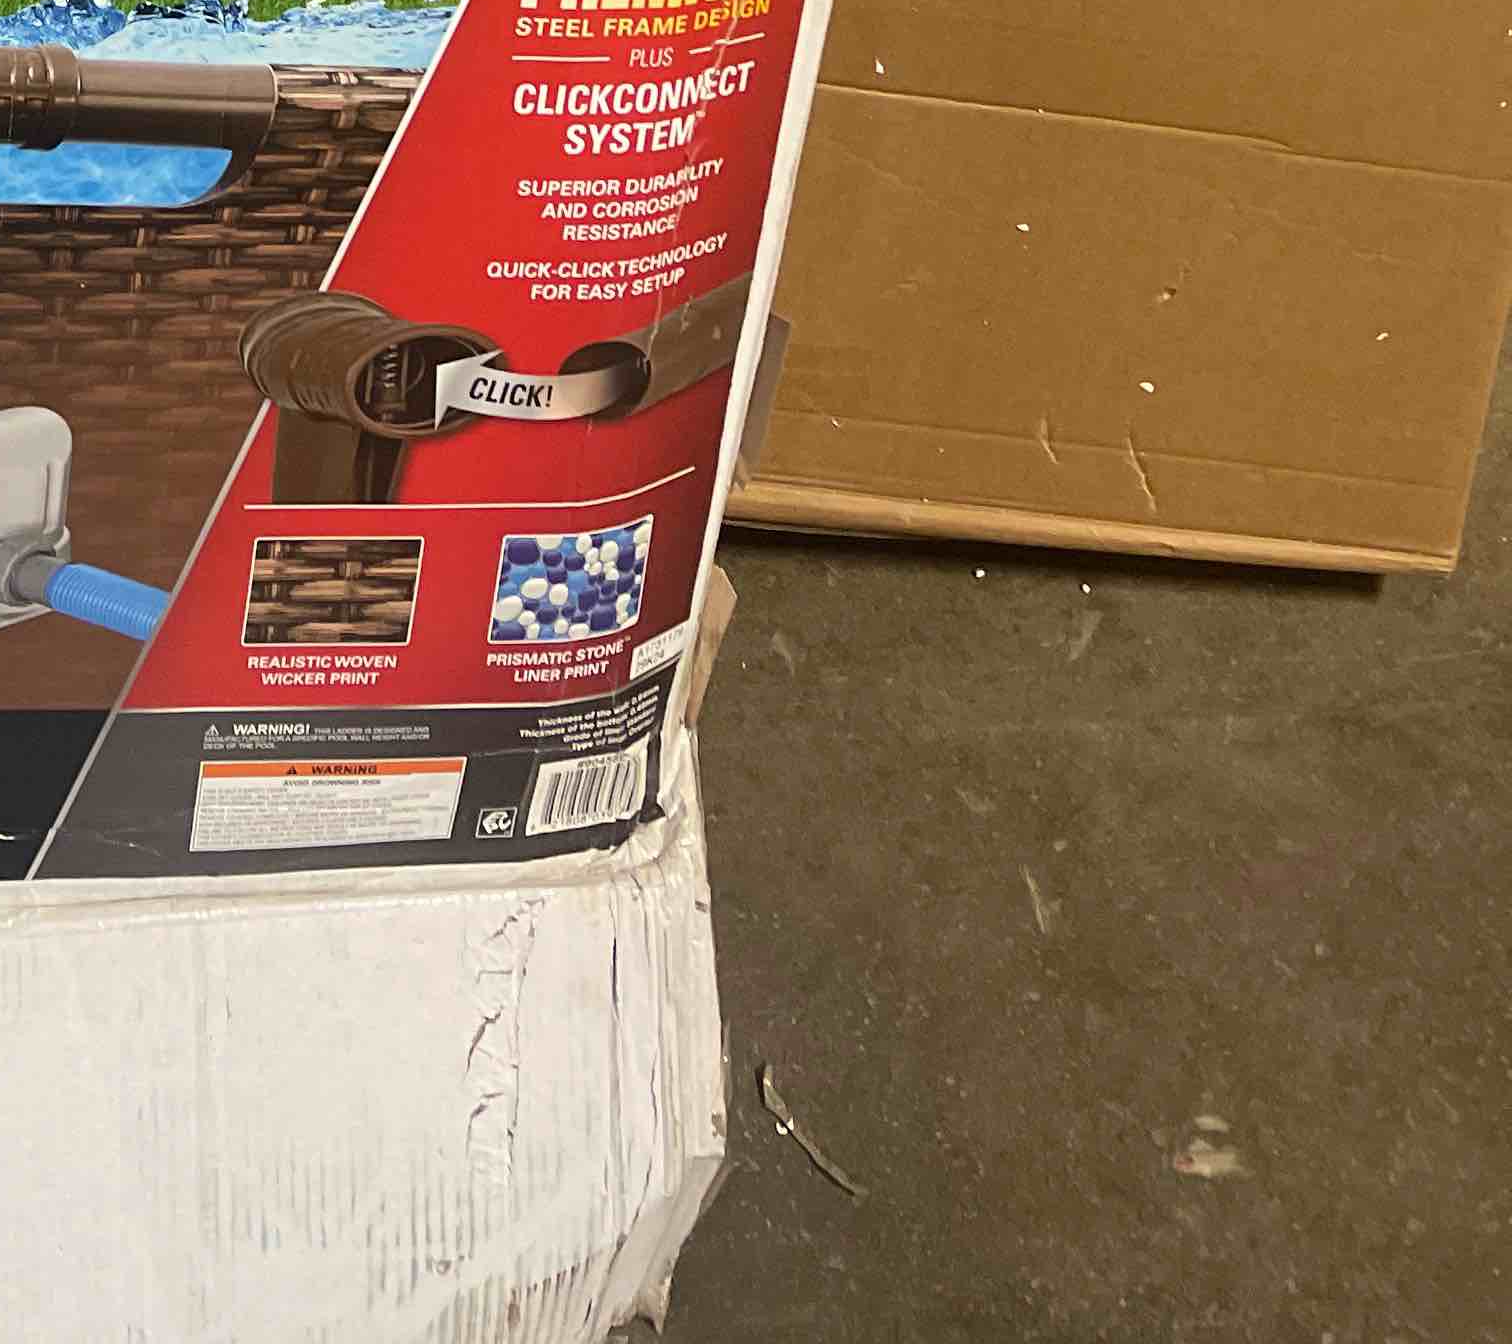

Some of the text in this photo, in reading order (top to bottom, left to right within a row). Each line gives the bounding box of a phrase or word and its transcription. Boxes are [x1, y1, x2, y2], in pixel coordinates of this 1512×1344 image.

[515, 16, 594, 38] STEEL
[603, 14, 687, 38] FRAME
[628, 46, 675, 68] PLUS
[512, 60, 756, 116] CLICKCONNECT
[517, 178, 621, 199] SUPERIOR
[541, 186, 699, 220] AND CORROSION
[562, 213, 677, 242] RESISTANCE
[486, 232, 729, 281] QUICK-CLICK TECHNOLOGY
[530, 266, 687, 301] FOR EASY SETUP
[468, 376, 554, 409] CLICK!
[247, 653, 398, 670] REALISTIC WOVEN
[486, 648, 572, 667] PRISMATIC
[261, 670, 381, 686] WICKER PRINT
[514, 660, 610, 683] LINER PRINT
[232, 723, 311, 736] WARNING!
[310, 764, 378, 775] WARNING
